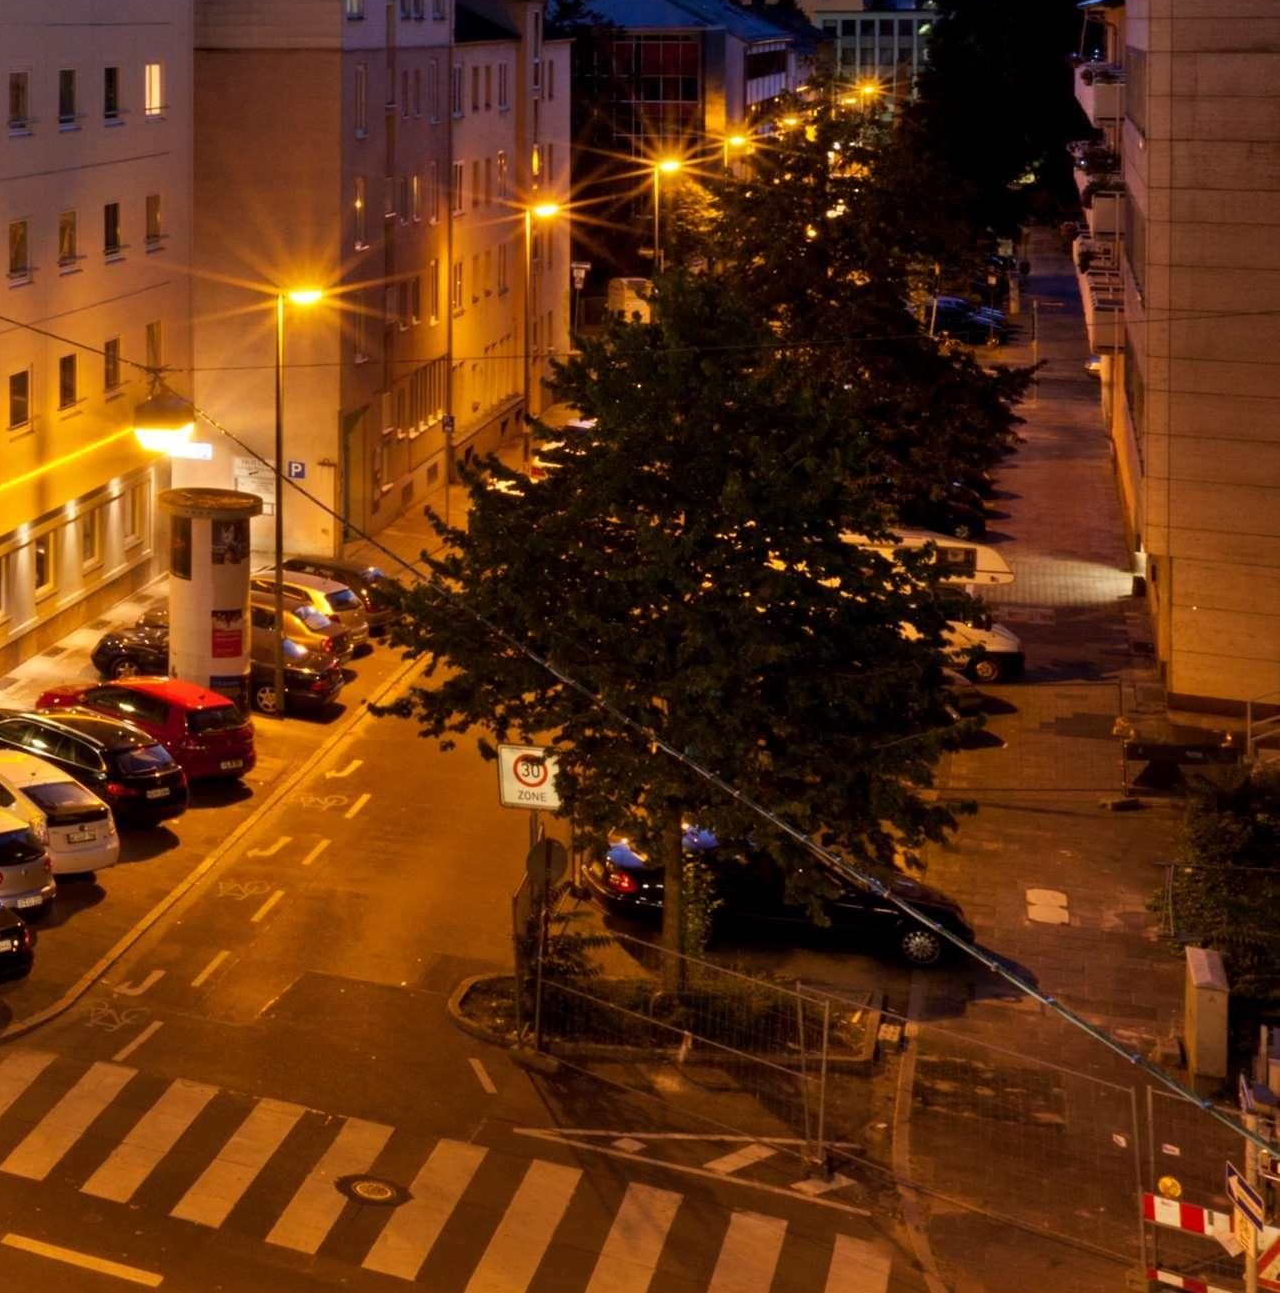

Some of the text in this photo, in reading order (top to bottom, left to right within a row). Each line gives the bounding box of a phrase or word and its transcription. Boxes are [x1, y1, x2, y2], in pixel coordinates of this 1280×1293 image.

[291, 463, 302, 477] P
[521, 761, 541, 779] 30
[518, 789, 547, 803] ZONE
